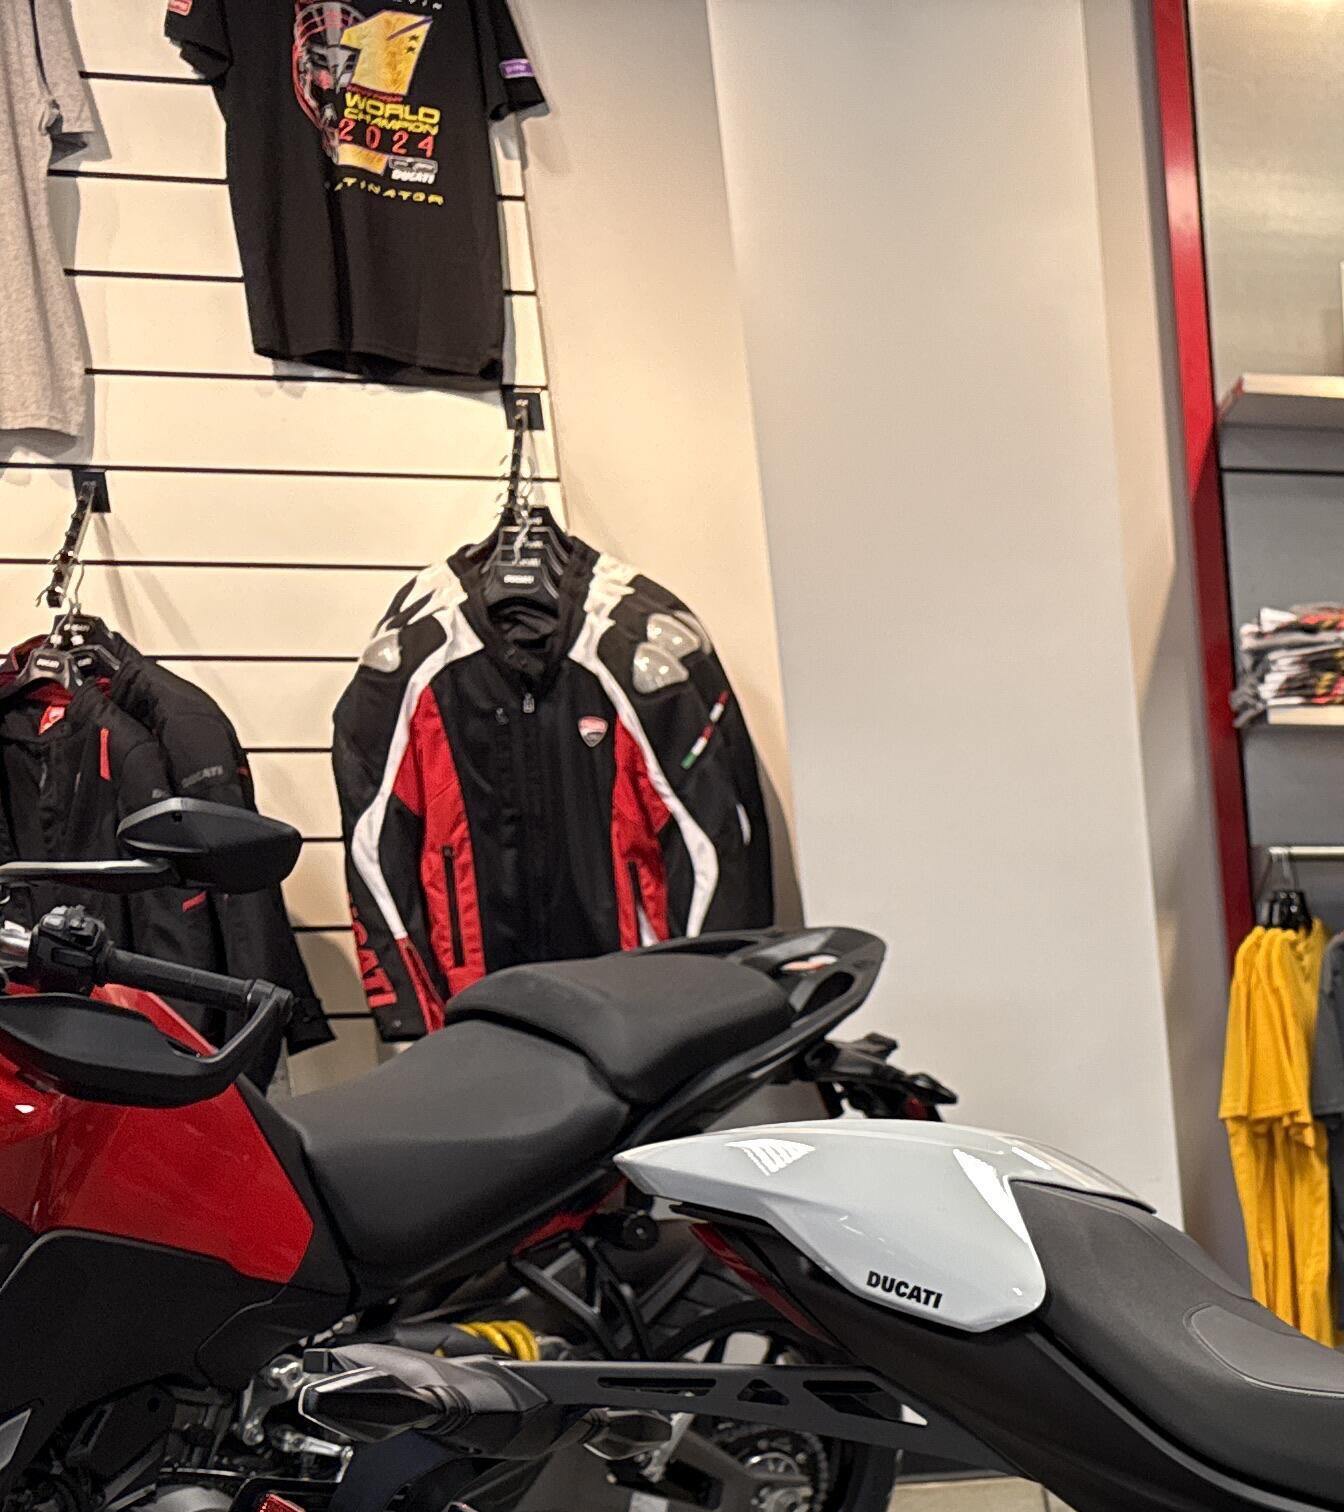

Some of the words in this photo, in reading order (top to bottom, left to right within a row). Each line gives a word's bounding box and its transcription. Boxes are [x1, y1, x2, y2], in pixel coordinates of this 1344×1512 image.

[343, 91, 442, 125] WORLD
[343, 108, 439, 136] CHAMPION
[338, 118, 435, 159] 2024
[391, 169, 437, 185] DUCATI
[866, 1270, 944, 1310] DUCATI
